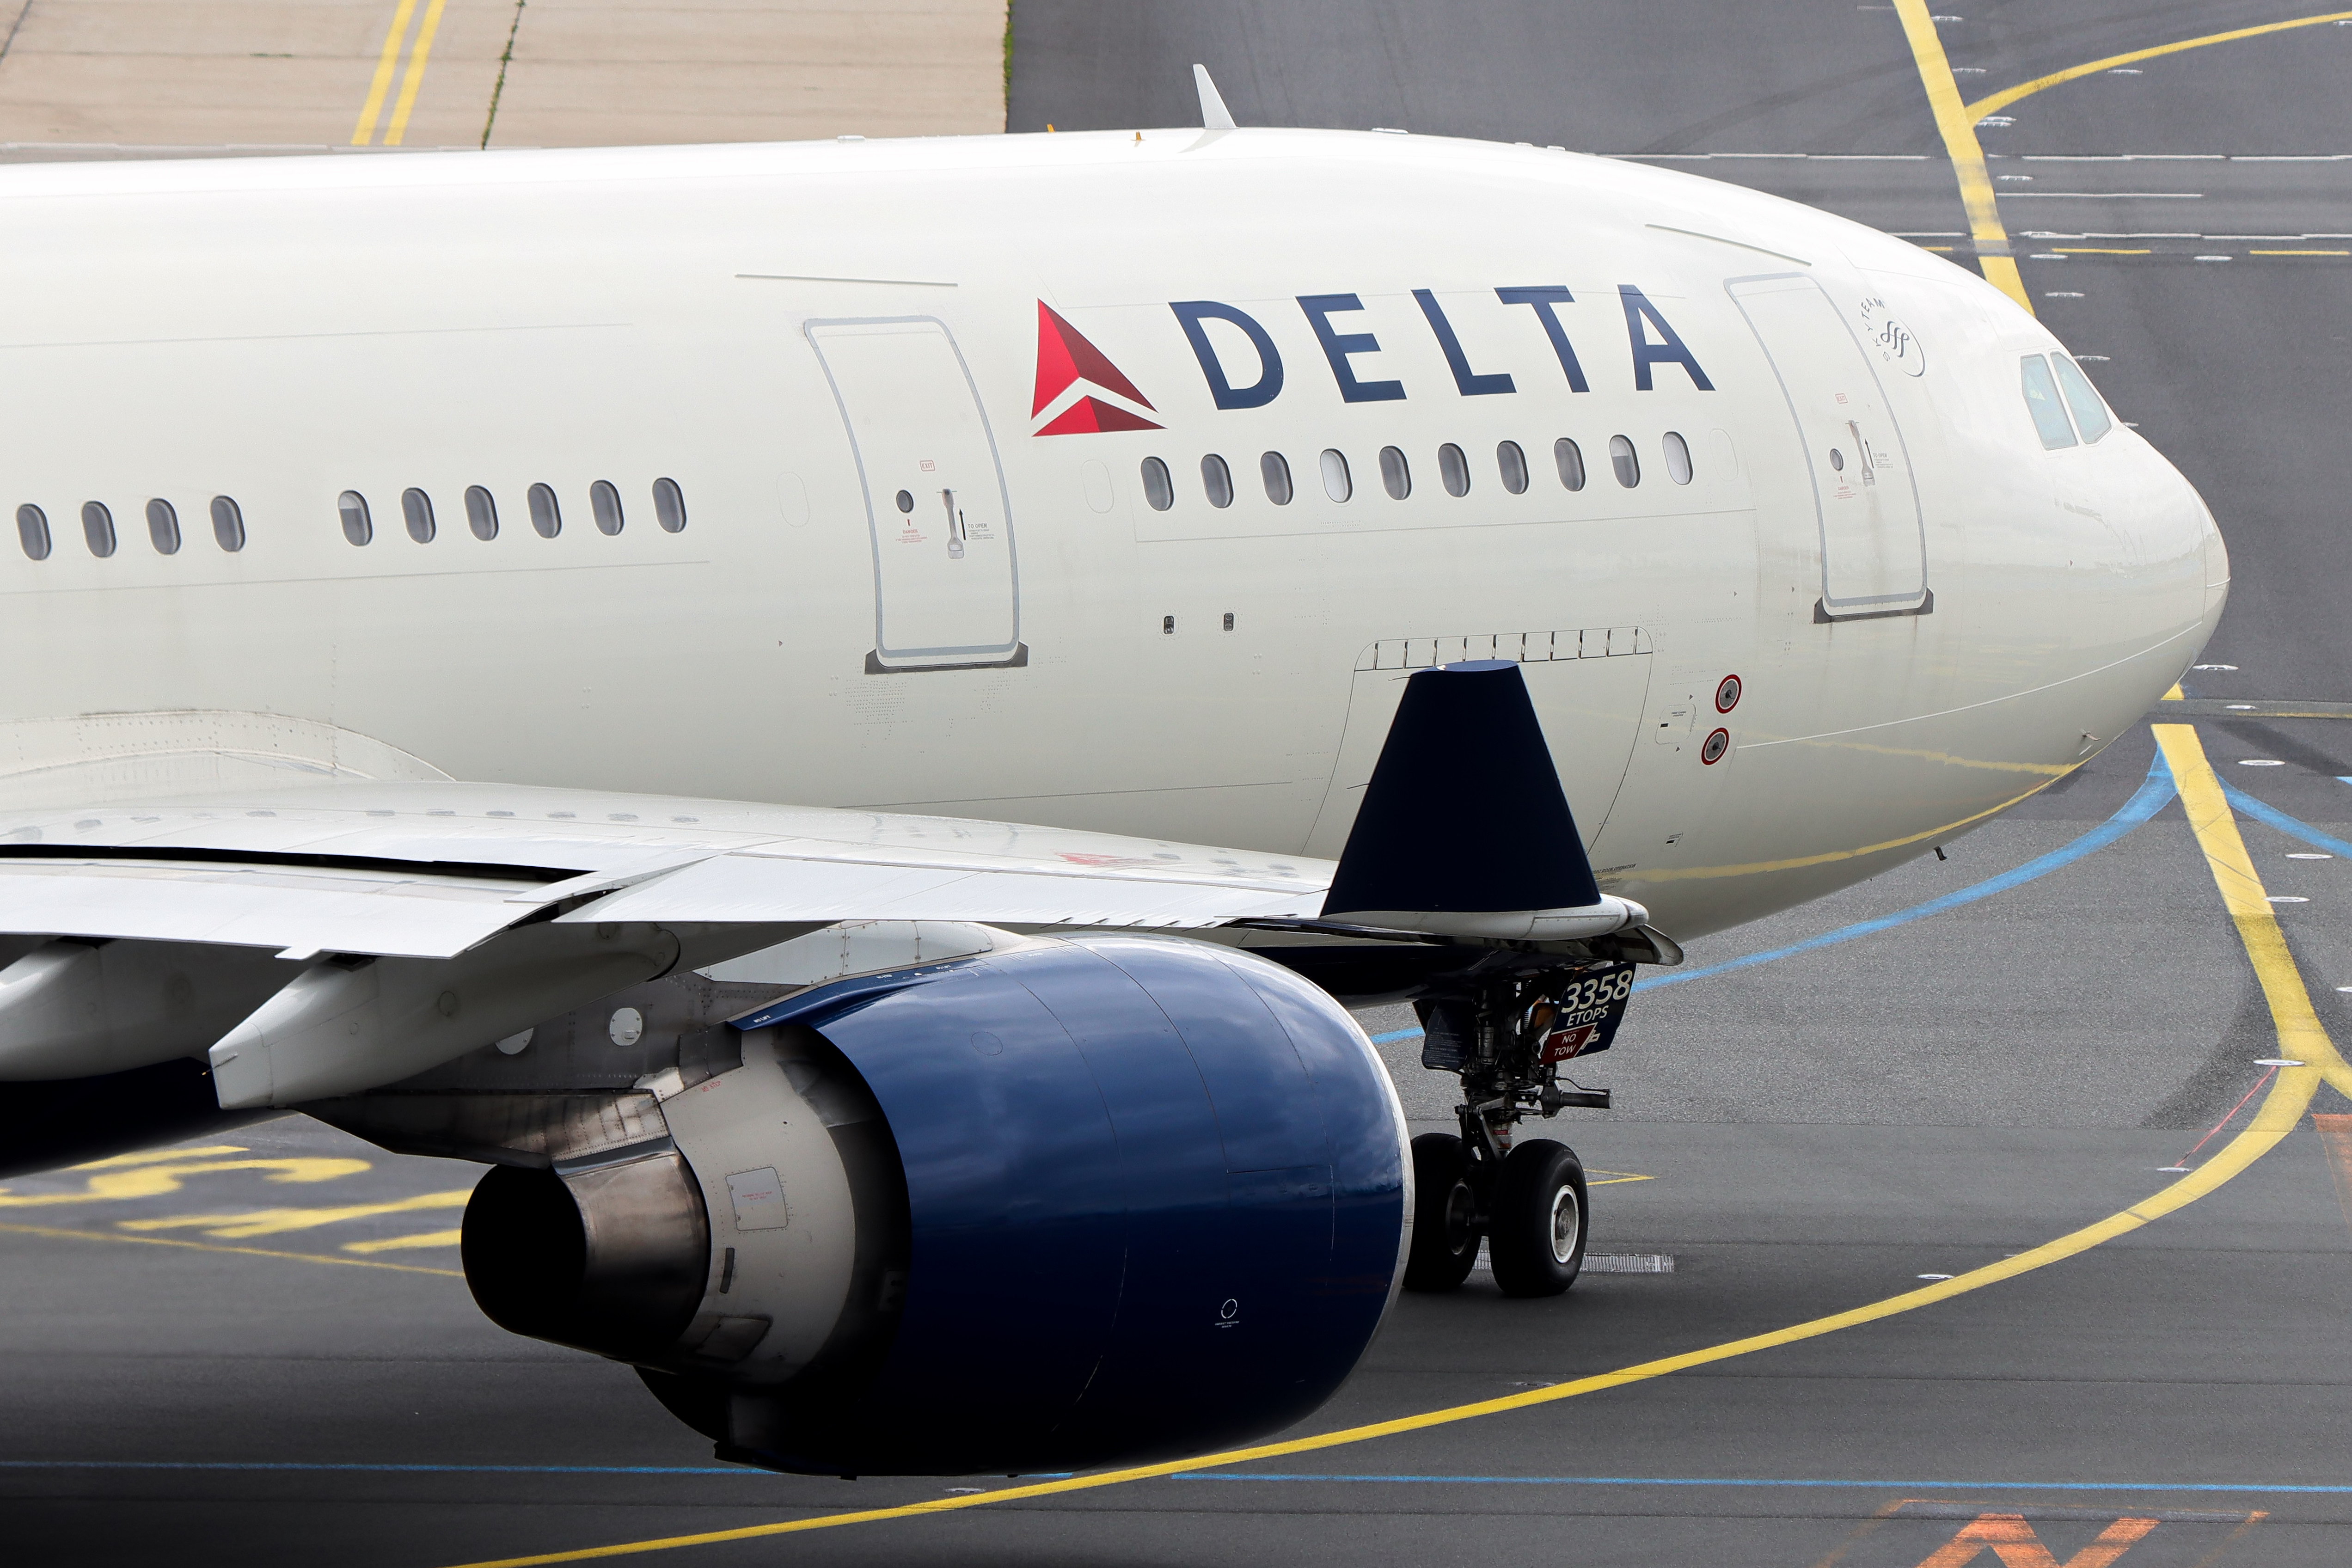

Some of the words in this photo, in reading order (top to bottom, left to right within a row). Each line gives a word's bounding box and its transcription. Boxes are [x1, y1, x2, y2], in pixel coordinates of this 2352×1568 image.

[1169, 284, 1715, 410] DELTA
[1561, 970, 1633, 1013] 3358
[1567, 1005, 1609, 1027] ETOPS
[1562, 1034, 1576, 1044] NO
[1555, 1044, 1577, 1057] TOW
